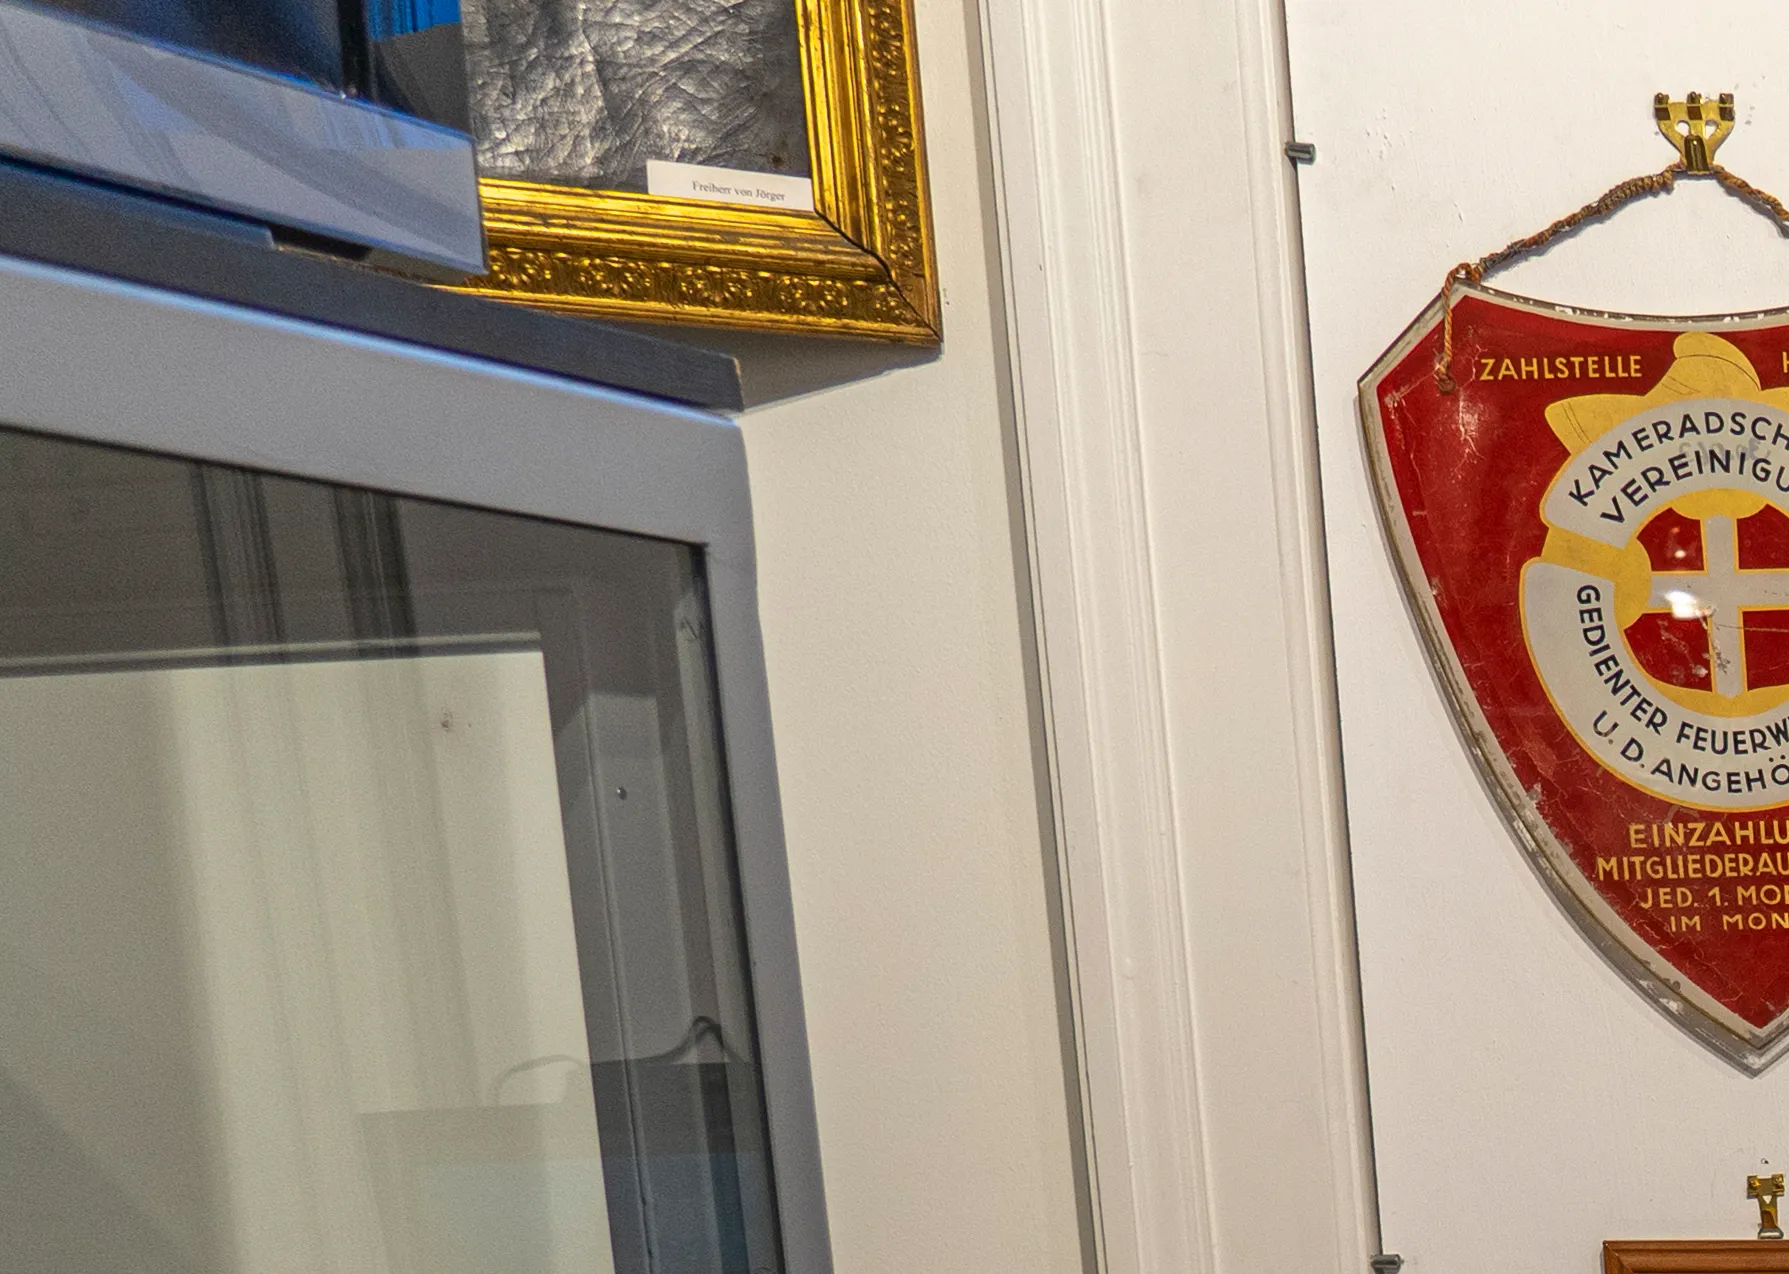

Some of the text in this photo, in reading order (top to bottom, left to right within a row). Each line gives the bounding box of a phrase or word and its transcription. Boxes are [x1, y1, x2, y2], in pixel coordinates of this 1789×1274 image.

[691, 180, 785, 202] Freiherr von Jörger
[1479, 355, 1643, 383] ZAHLSTELLE
[1576, 583, 1669, 736] GEDIENTER
[1669, 915, 1702, 932] IM
